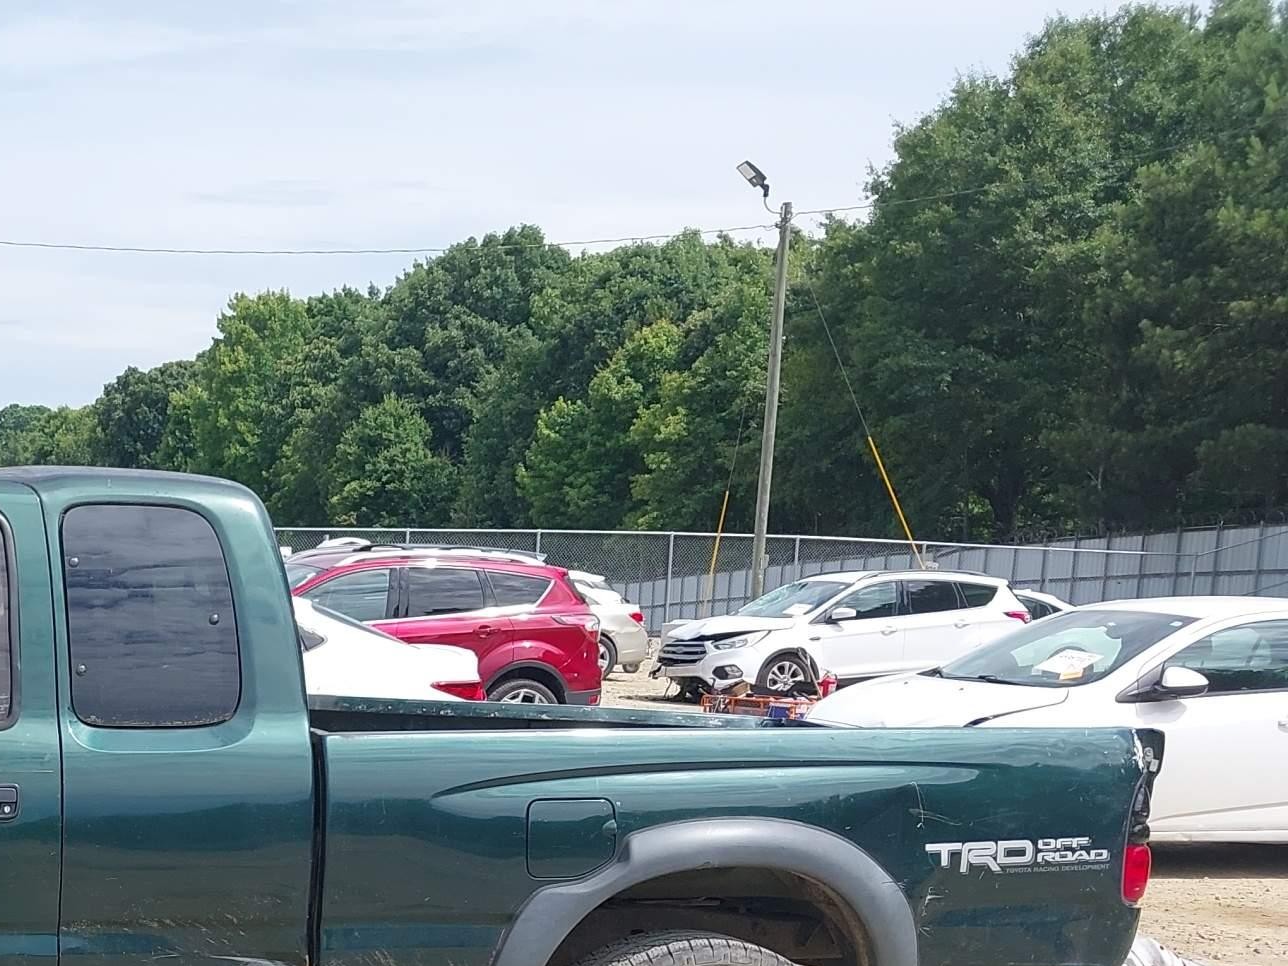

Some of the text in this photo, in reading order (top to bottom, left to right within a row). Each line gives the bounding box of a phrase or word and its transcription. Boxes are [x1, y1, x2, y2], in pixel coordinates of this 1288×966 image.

[1037, 836, 1091, 850] OFF
[925, 839, 1035, 875] TRD
[1037, 849, 1110, 864] ROAD
